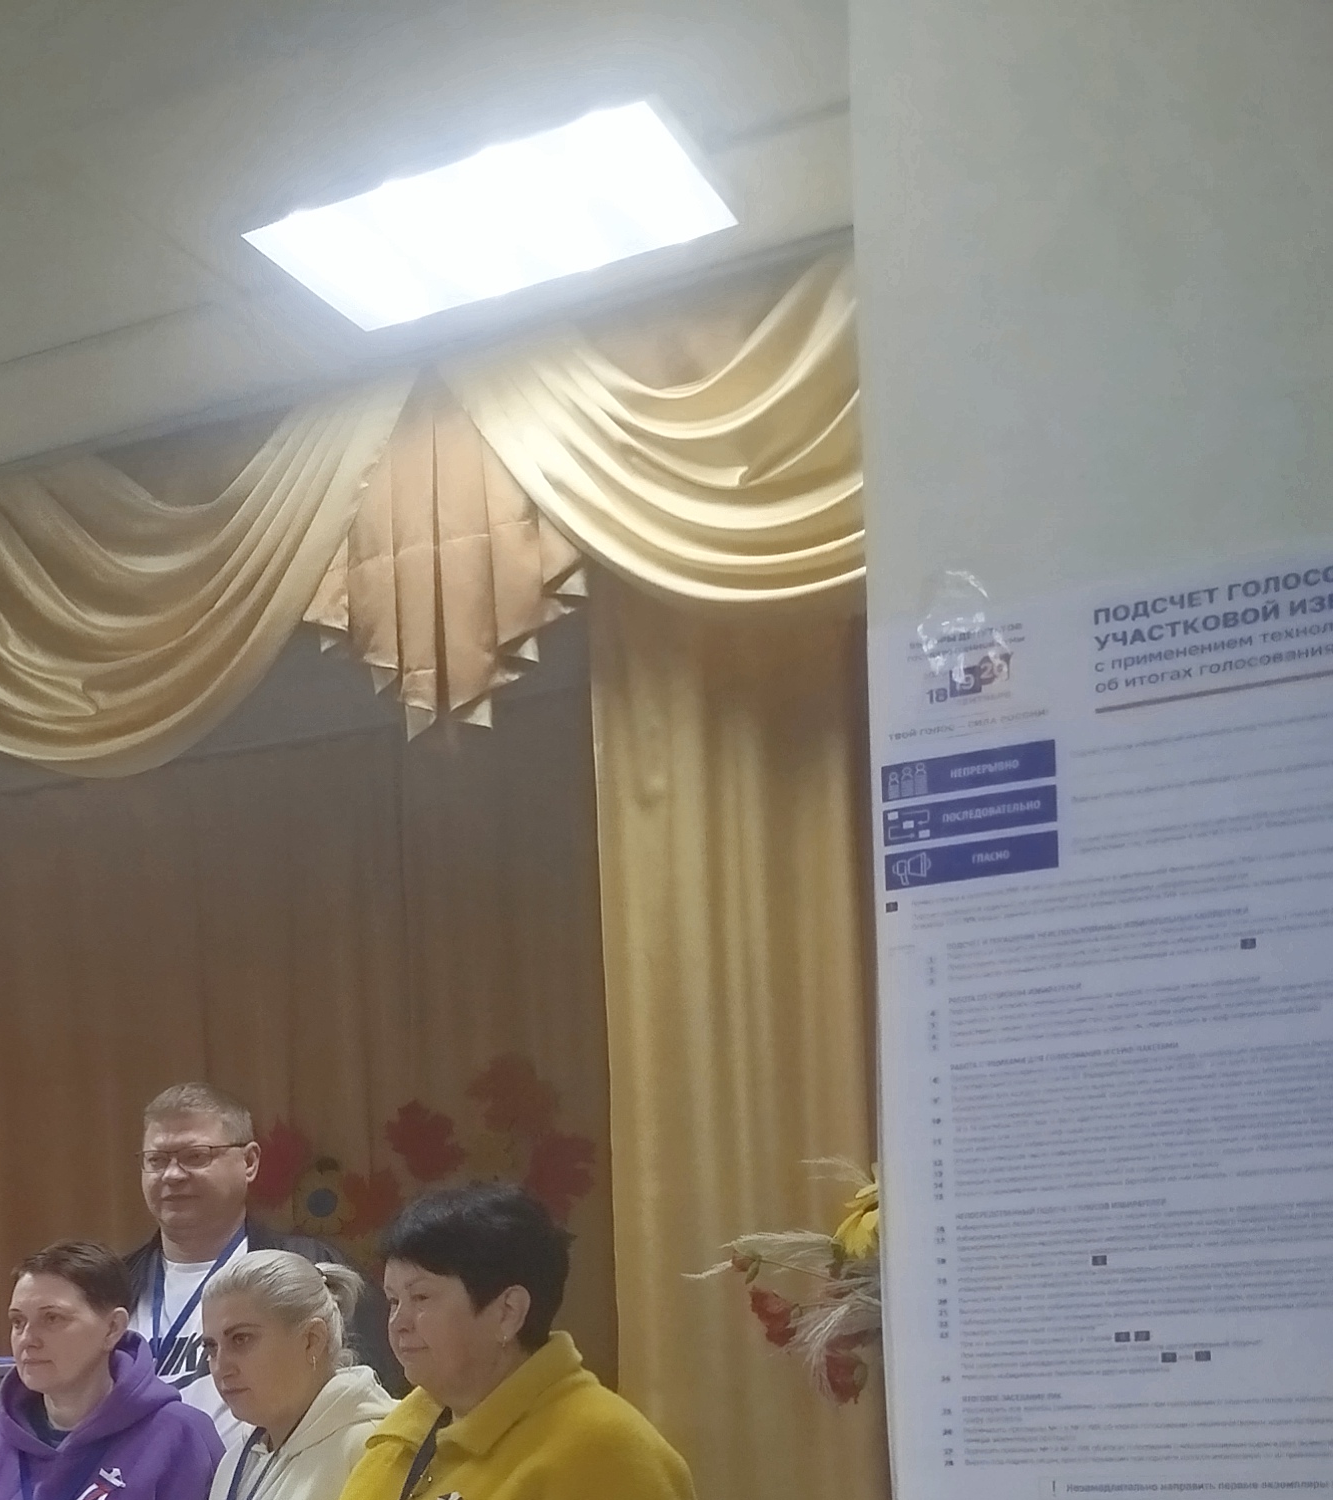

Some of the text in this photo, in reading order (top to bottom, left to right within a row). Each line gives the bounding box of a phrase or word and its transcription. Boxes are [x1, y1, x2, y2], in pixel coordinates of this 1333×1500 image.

[1093, 586, 1219, 626] ПОДСЧЕТ
[1093, 599, 1281, 652] УЧАСТКОВОЙ
[1094, 662, 1105, 673] с
[1111, 634, 1254, 671] применением
[1095, 678, 1119, 694] об
[1124, 667, 1193, 688] итогах
[950, 759, 1020, 779] НЕПРЕРЫВНО
[942, 800, 1041, 823] ПОСЛЕДОВАТЕЛЬНО
[972, 849, 1011, 865] ГЛАСНО
